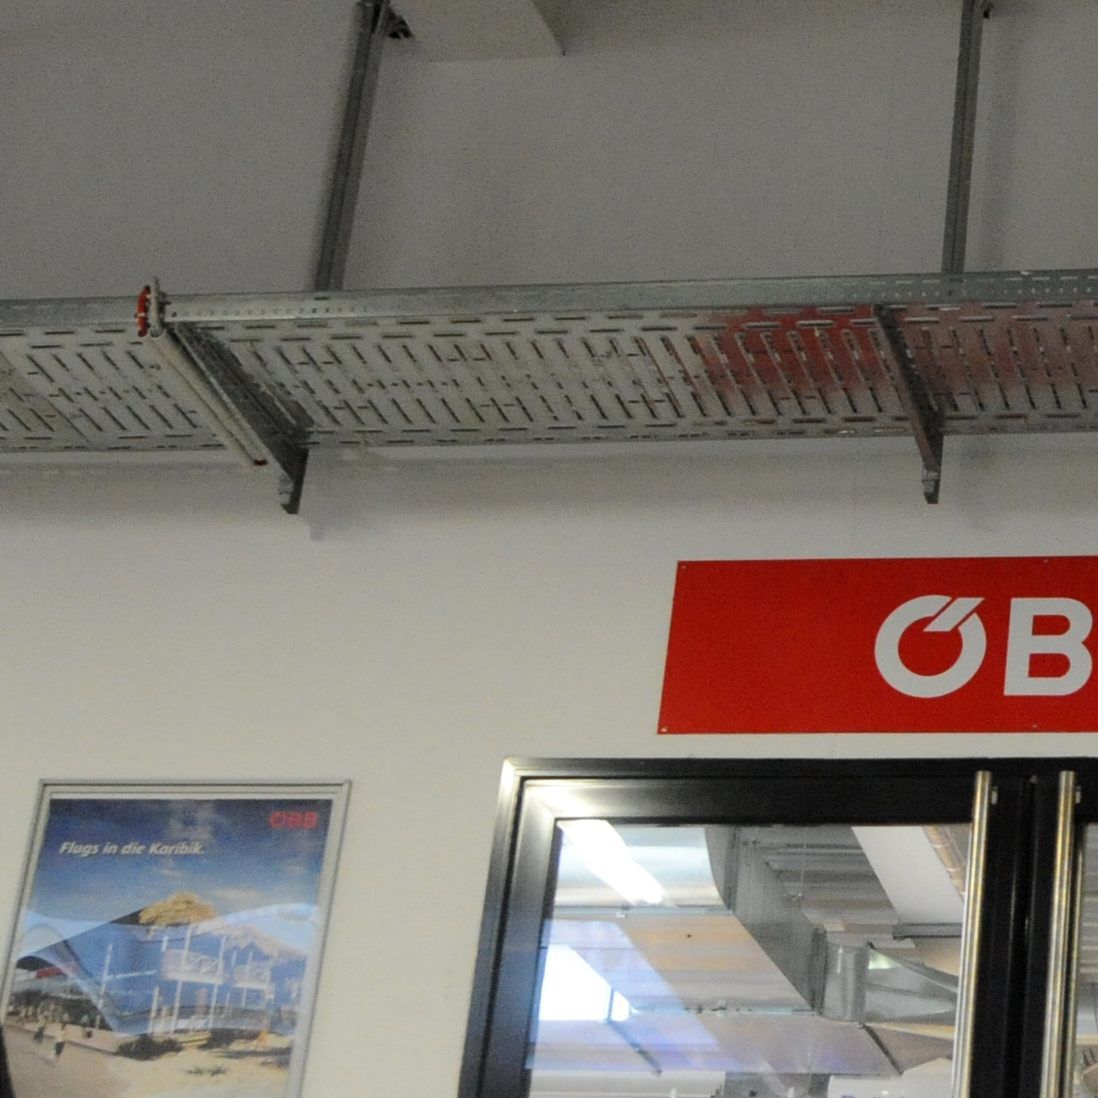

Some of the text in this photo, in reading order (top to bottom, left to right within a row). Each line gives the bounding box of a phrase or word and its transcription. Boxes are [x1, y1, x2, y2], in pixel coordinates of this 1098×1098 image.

[60, 841, 205, 857] Flugs in die Karibik.
